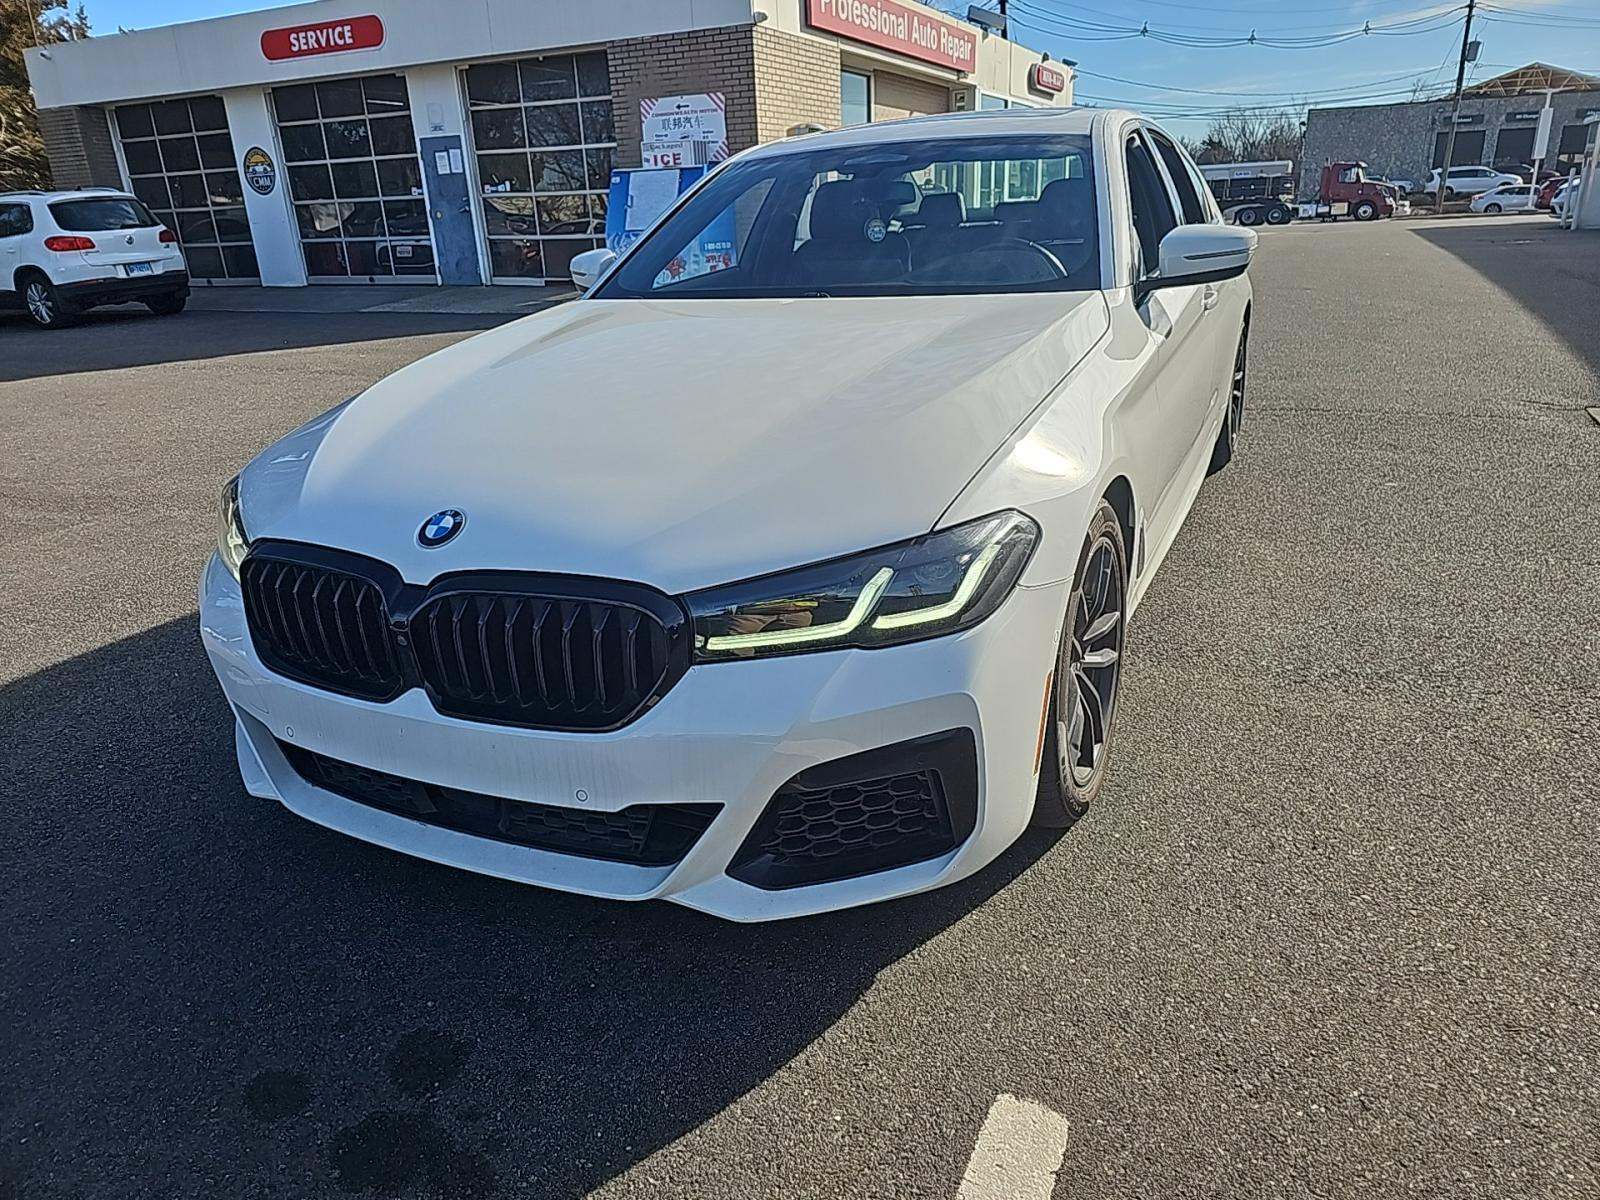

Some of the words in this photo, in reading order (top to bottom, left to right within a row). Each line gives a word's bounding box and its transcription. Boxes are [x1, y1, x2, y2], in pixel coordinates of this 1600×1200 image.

[289, 25, 353, 52] SERVICE
[911, 16, 938, 50] Auto
[940, 26, 972, 64] Repair
[653, 153, 682, 166] ICE
